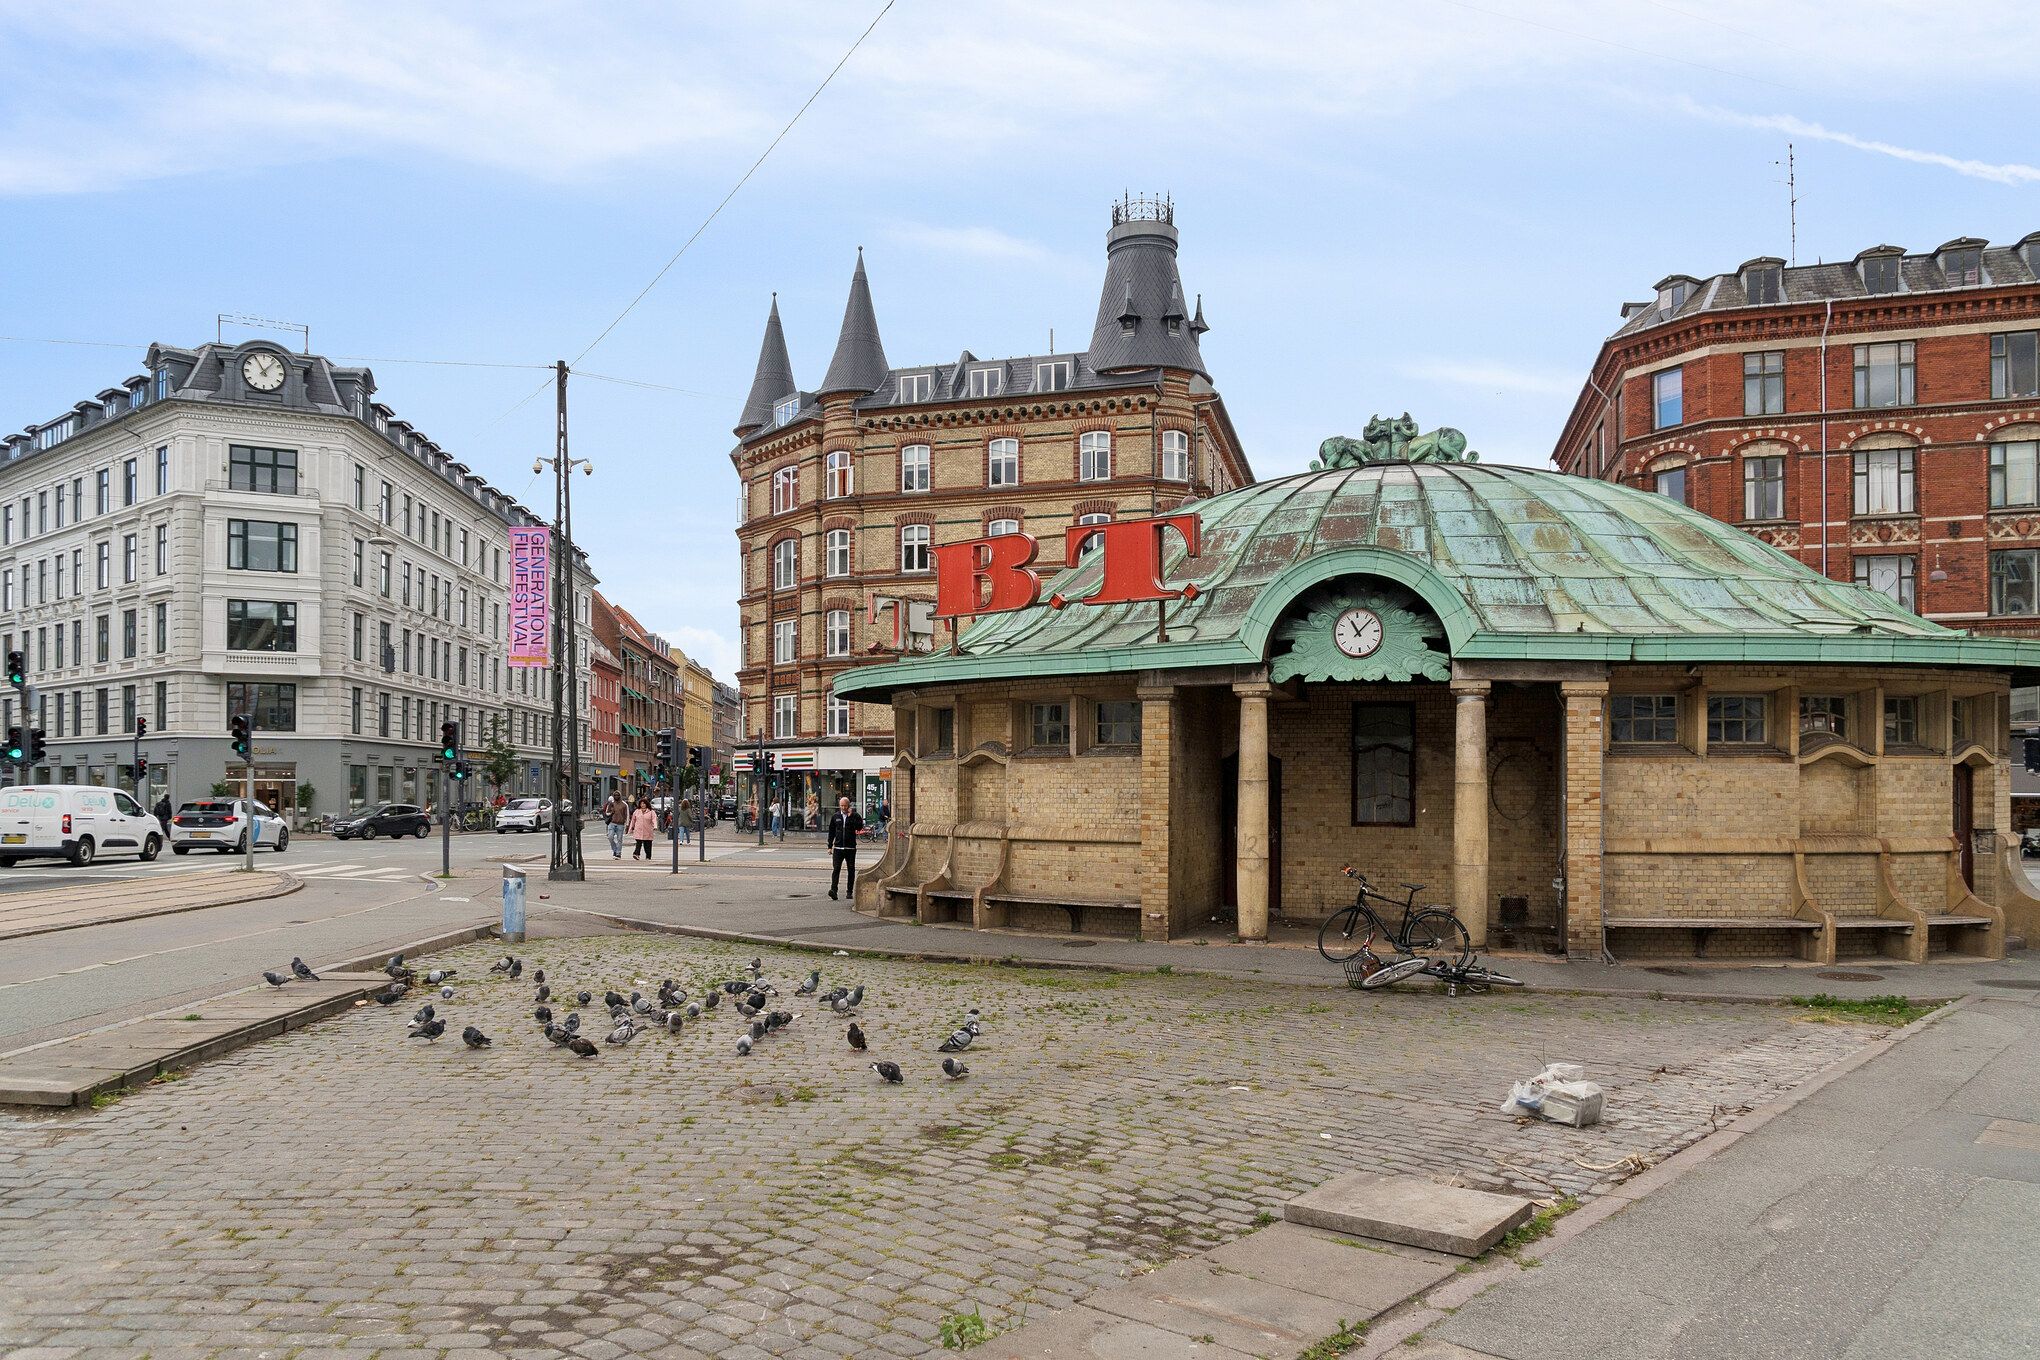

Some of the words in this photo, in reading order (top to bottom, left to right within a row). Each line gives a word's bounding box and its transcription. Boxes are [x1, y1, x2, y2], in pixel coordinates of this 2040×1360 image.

[513, 533, 529, 653] FILMFESTIVAL
[530, 533, 545, 646] GENERATION
[926, 512, 1204, 620] B.T.
[252, 745, 277, 755] OLIA
